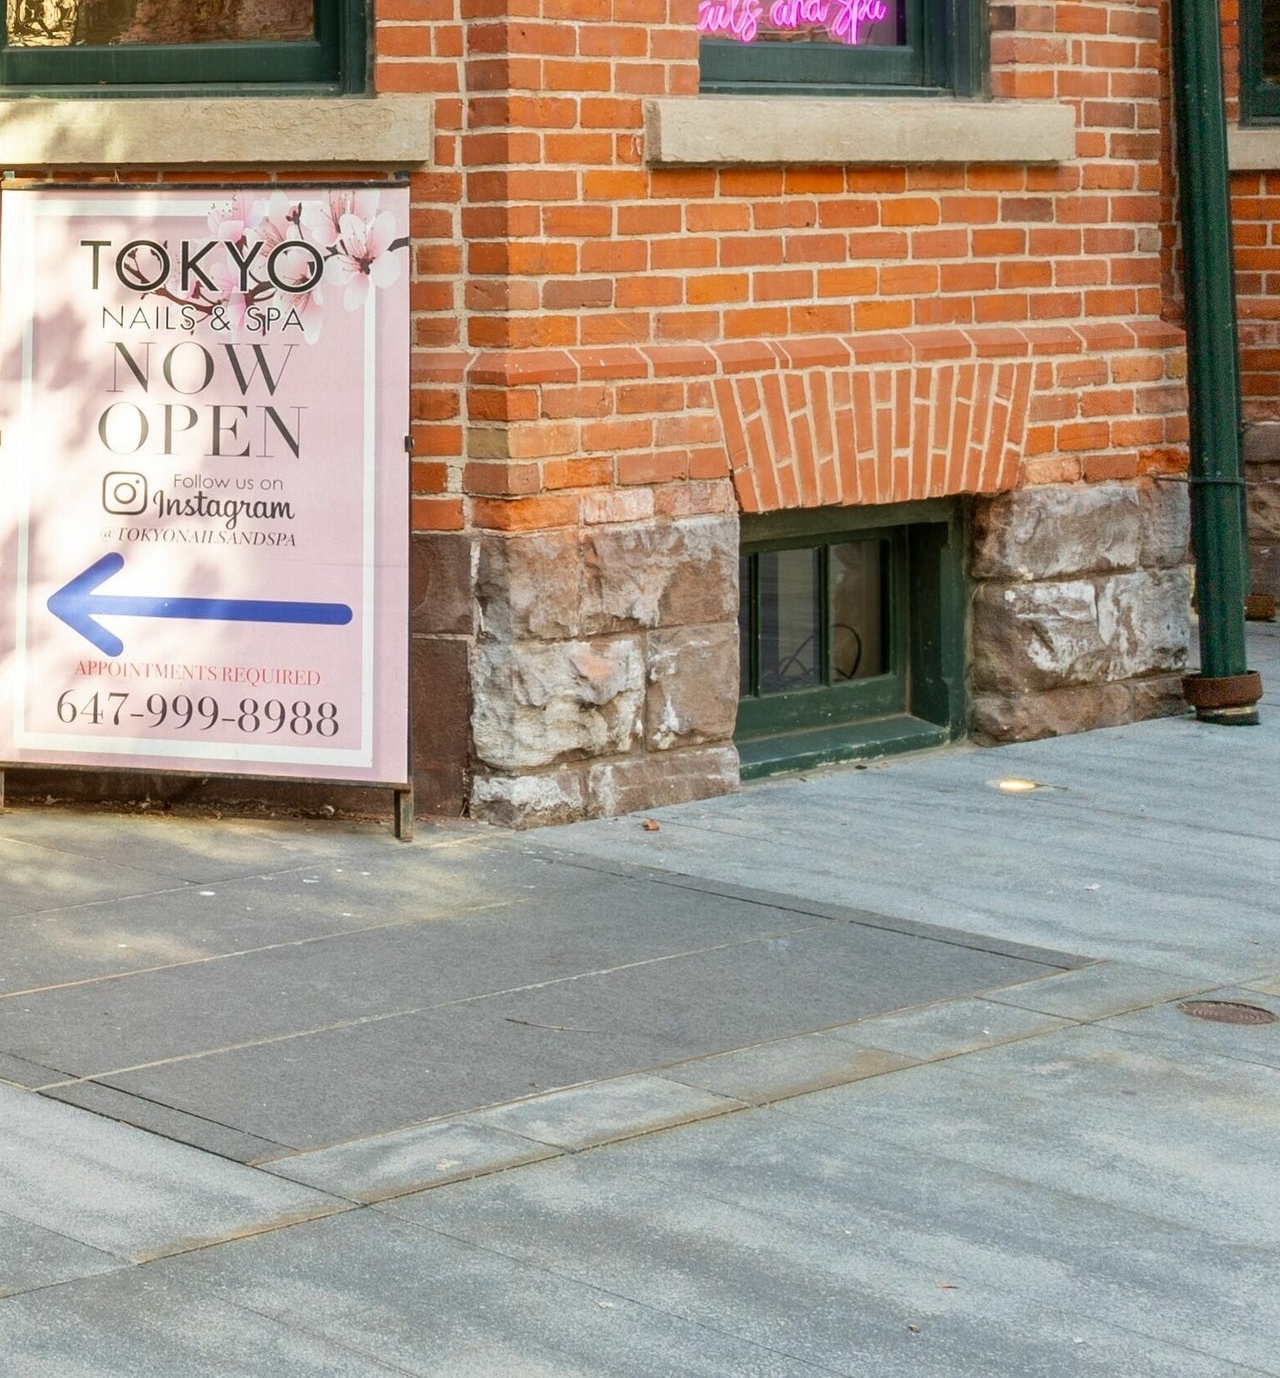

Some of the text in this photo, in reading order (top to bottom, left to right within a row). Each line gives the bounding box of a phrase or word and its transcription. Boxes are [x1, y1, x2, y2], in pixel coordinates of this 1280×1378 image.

[80, 240, 324, 293] TOKYO
[102, 305, 304, 332] NAILS & SPA
[105, 341, 301, 396] NOW
[98, 402, 309, 459] OPEN
[173, 474, 283, 491] Follow us on
[152, 490, 295, 530] Instagram
[100, 527, 297, 547] @TOKYONAILSANDSPA
[75, 660, 321, 687] APPOINTMENTS REQUIRED
[56, 688, 339, 737] 647-999-8988
